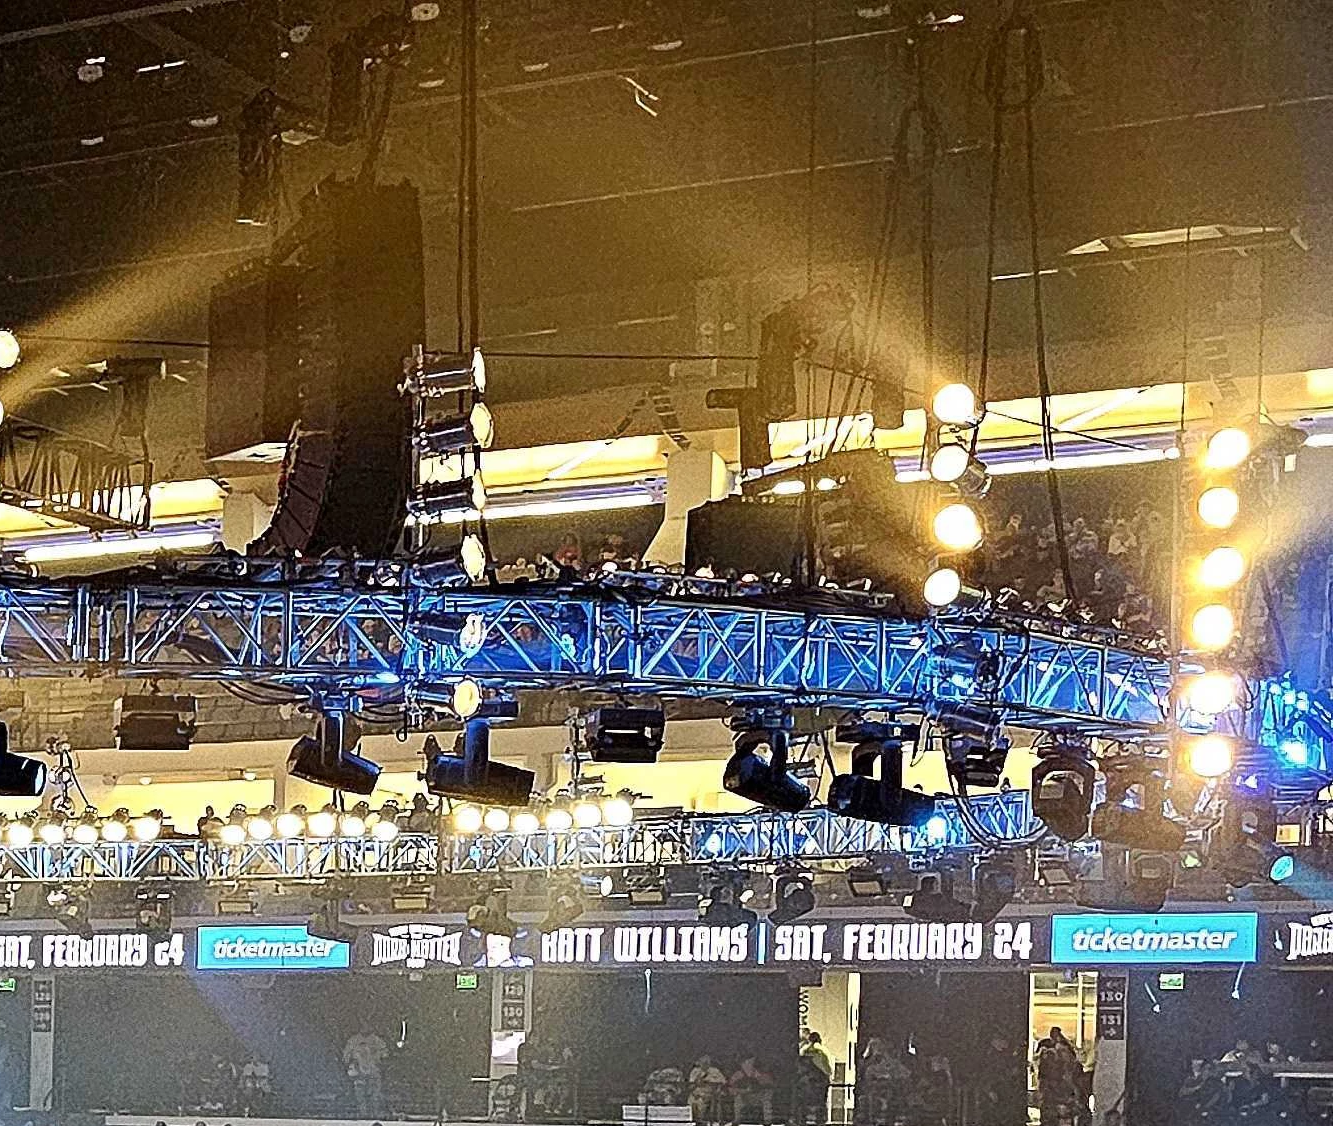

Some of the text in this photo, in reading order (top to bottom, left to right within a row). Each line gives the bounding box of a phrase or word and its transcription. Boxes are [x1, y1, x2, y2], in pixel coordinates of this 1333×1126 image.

[42, 933, 148, 968] FEBRUARY
[213, 936, 335, 959] ticketmaster
[613, 924, 749, 962] WILLIAMS
[842, 922, 983, 961] FEBRUARY
[993, 921, 1033, 961] 24
[1072, 927, 1238, 951] ticketmaster
[1099, 991, 1124, 1003] 130
[1099, 1014, 1123, 1025] 131
